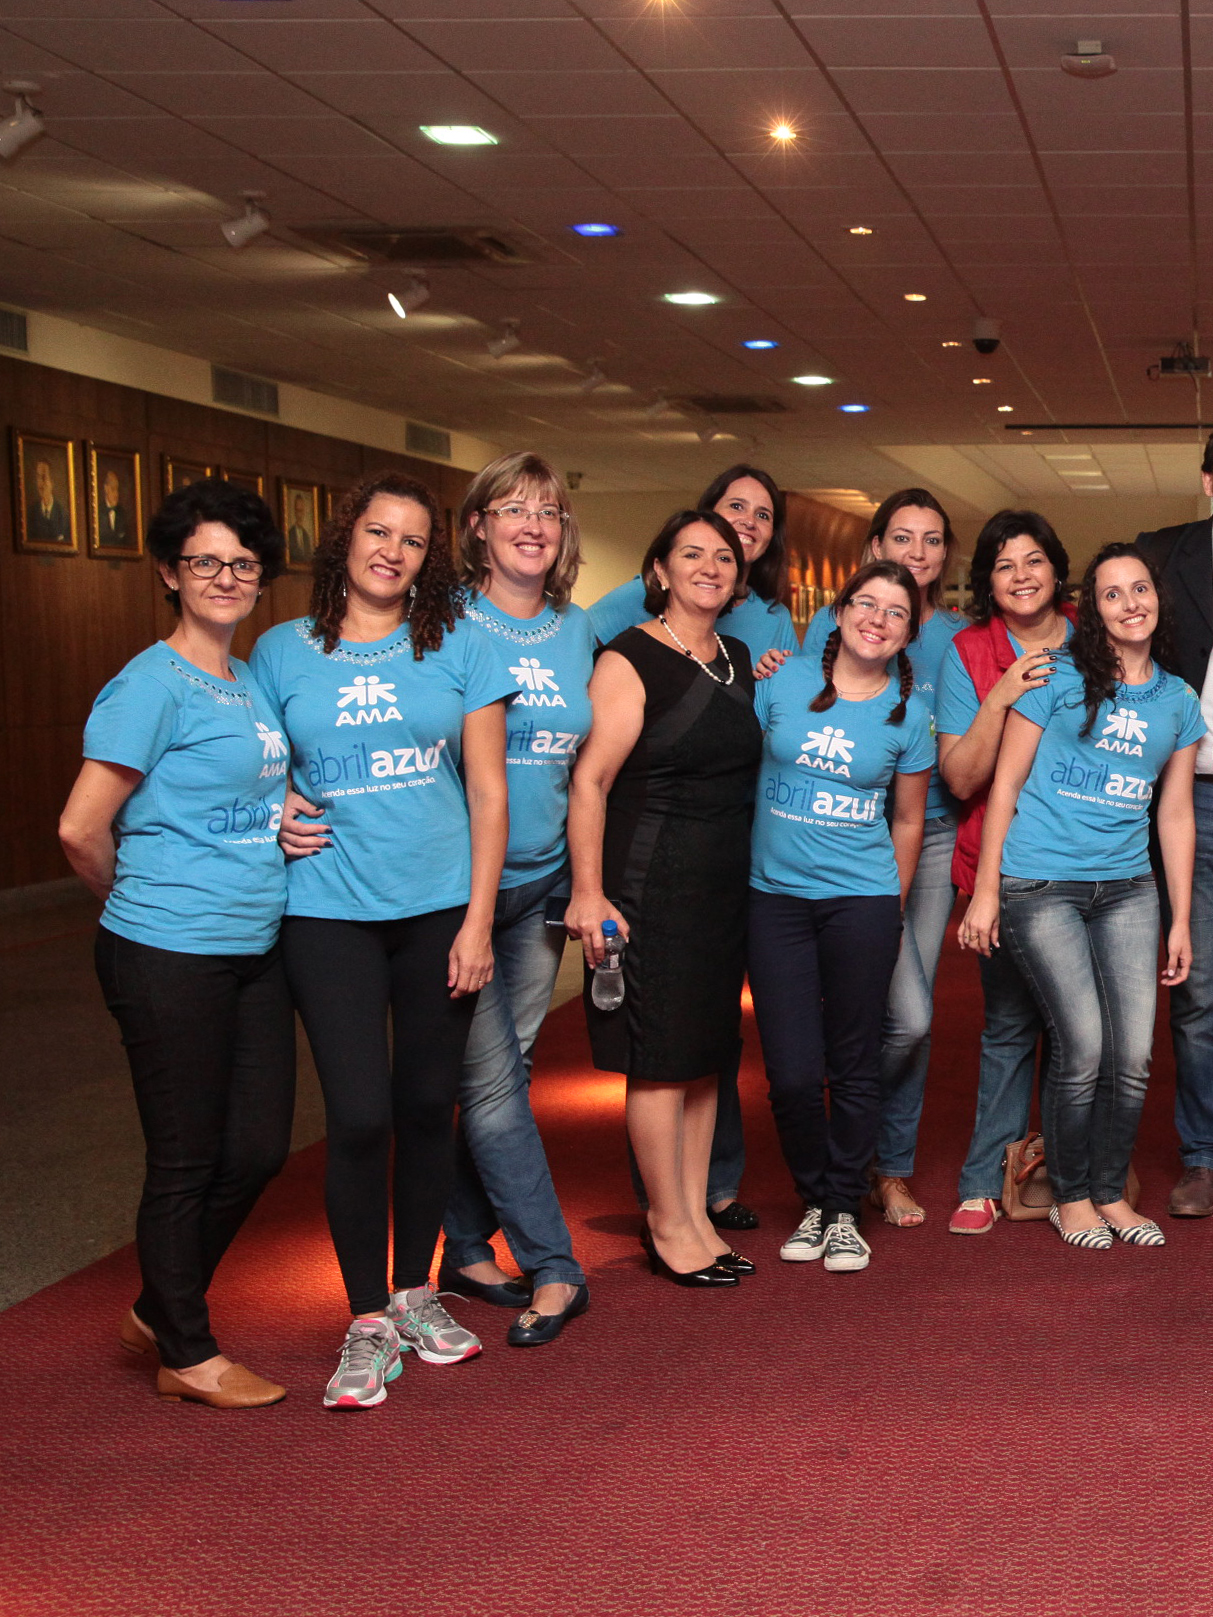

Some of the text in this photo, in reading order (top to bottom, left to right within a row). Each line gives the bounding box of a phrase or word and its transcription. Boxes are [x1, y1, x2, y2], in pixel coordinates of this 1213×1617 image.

[511, 693, 567, 708] AMA
[335, 706, 403, 727] AMA
[1094, 738, 1143, 757] AMA
[258, 760, 287, 779] AMA
[795, 753, 851, 778] AMA
[1050, 757, 1153, 800] abrilazu
[346, 787, 365, 795] essa
[366, 784, 379, 793] luz
[392, 782, 406, 790] seu
[1056, 788, 1081, 799] Acenda
[1081, 794, 1096, 802] essa
[1096, 796, 1106, 804] luz
[207, 796, 284, 834] abrila
[787, 813, 802, 821] essa
[803, 816, 813, 824] luz
